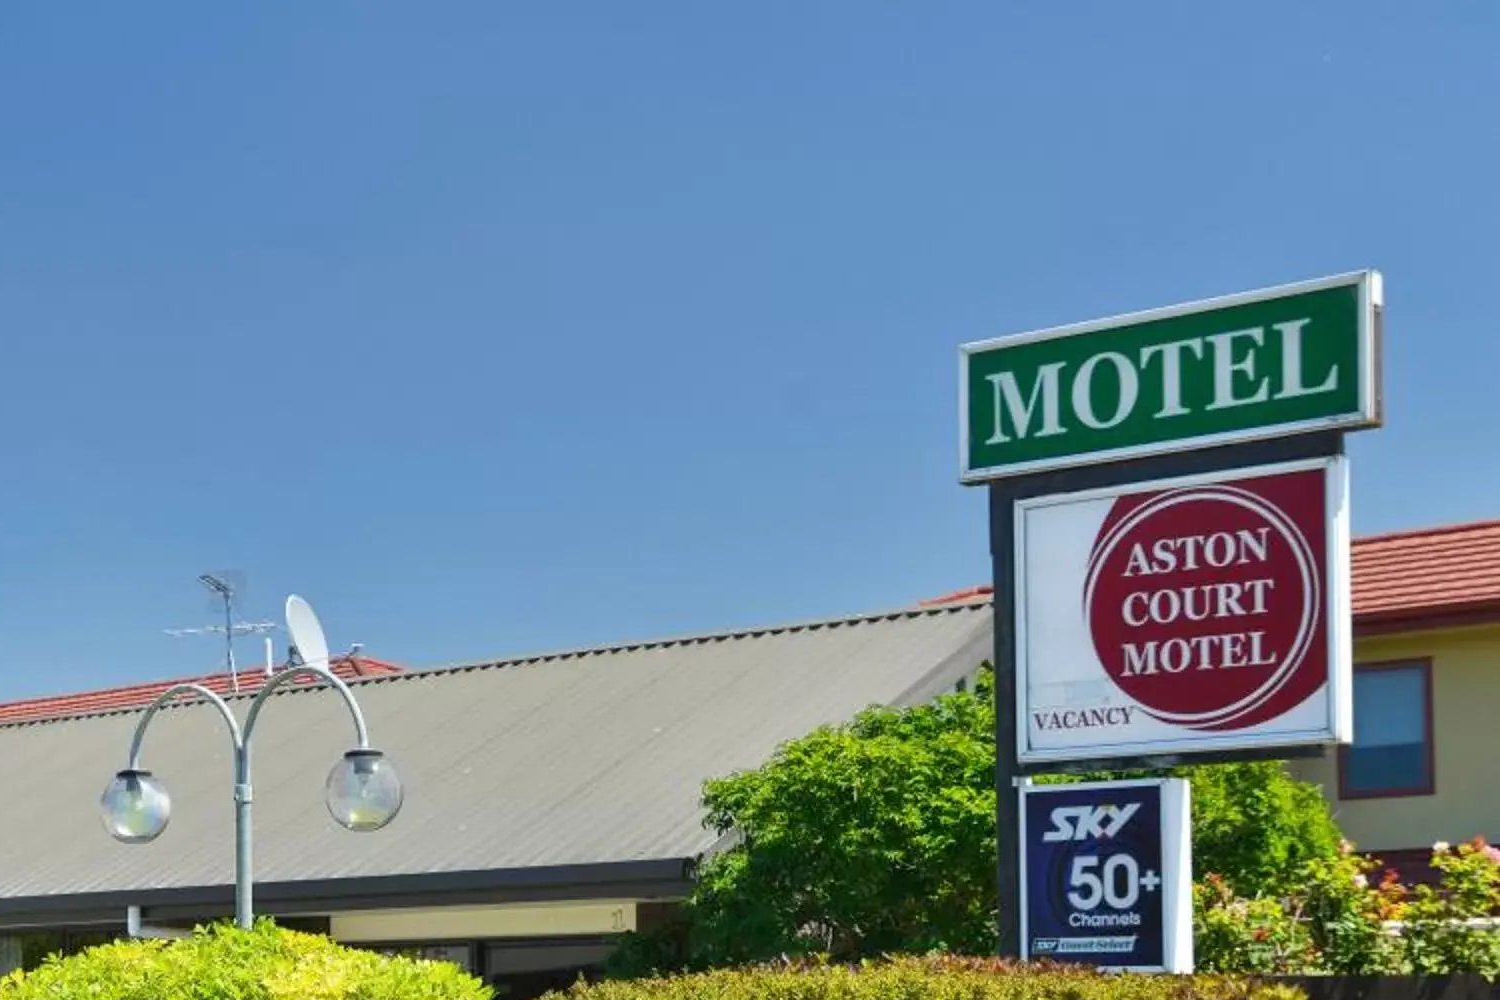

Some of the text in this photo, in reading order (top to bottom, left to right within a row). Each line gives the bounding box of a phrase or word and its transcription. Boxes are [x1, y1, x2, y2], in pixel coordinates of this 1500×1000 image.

[985, 318, 1338, 445] MOTEL
[1121, 527, 1270, 577] ASTON
[1122, 579, 1274, 627] COURT
[1120, 632, 1277, 677] MOTEL
[1033, 706, 1134, 730] VACANCY
[1043, 802, 1142, 842] SKY
[1068, 853, 1160, 910] 50+
[1068, 912, 1141, 927] Channels
